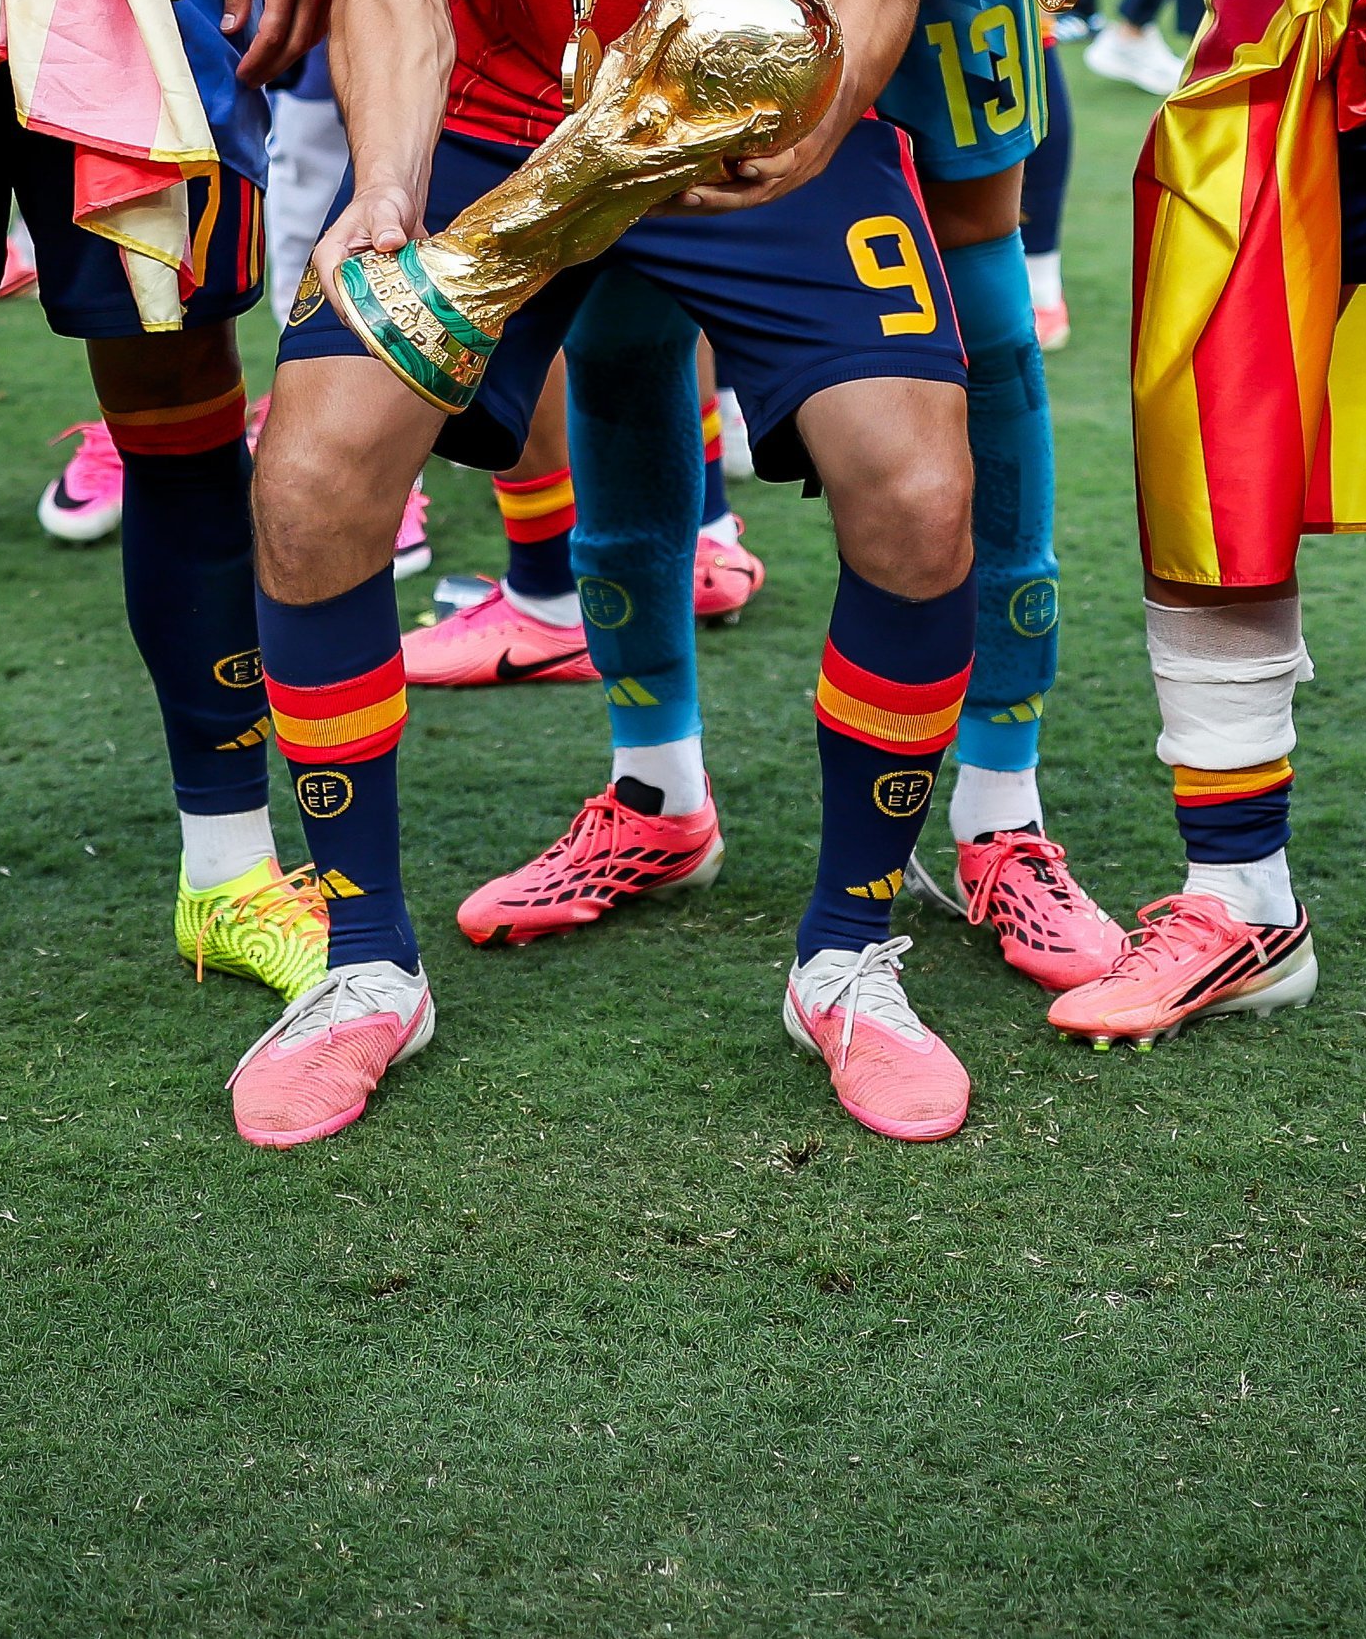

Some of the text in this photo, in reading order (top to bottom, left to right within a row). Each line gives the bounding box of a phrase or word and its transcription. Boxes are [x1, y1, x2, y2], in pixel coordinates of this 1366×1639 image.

[925, 5, 1026, 149] 13
[845, 214, 937, 337] 9
[382, 250, 424, 322] IFA
[387, 303, 429, 347] CUP
[1024, 589, 1053, 608] RF
[1023, 607, 1052, 627] EF
[306, 780, 337, 794] RF
[889, 779, 924, 793] RF
[307, 794, 338, 808] EF
[887, 792, 921, 806] EF
